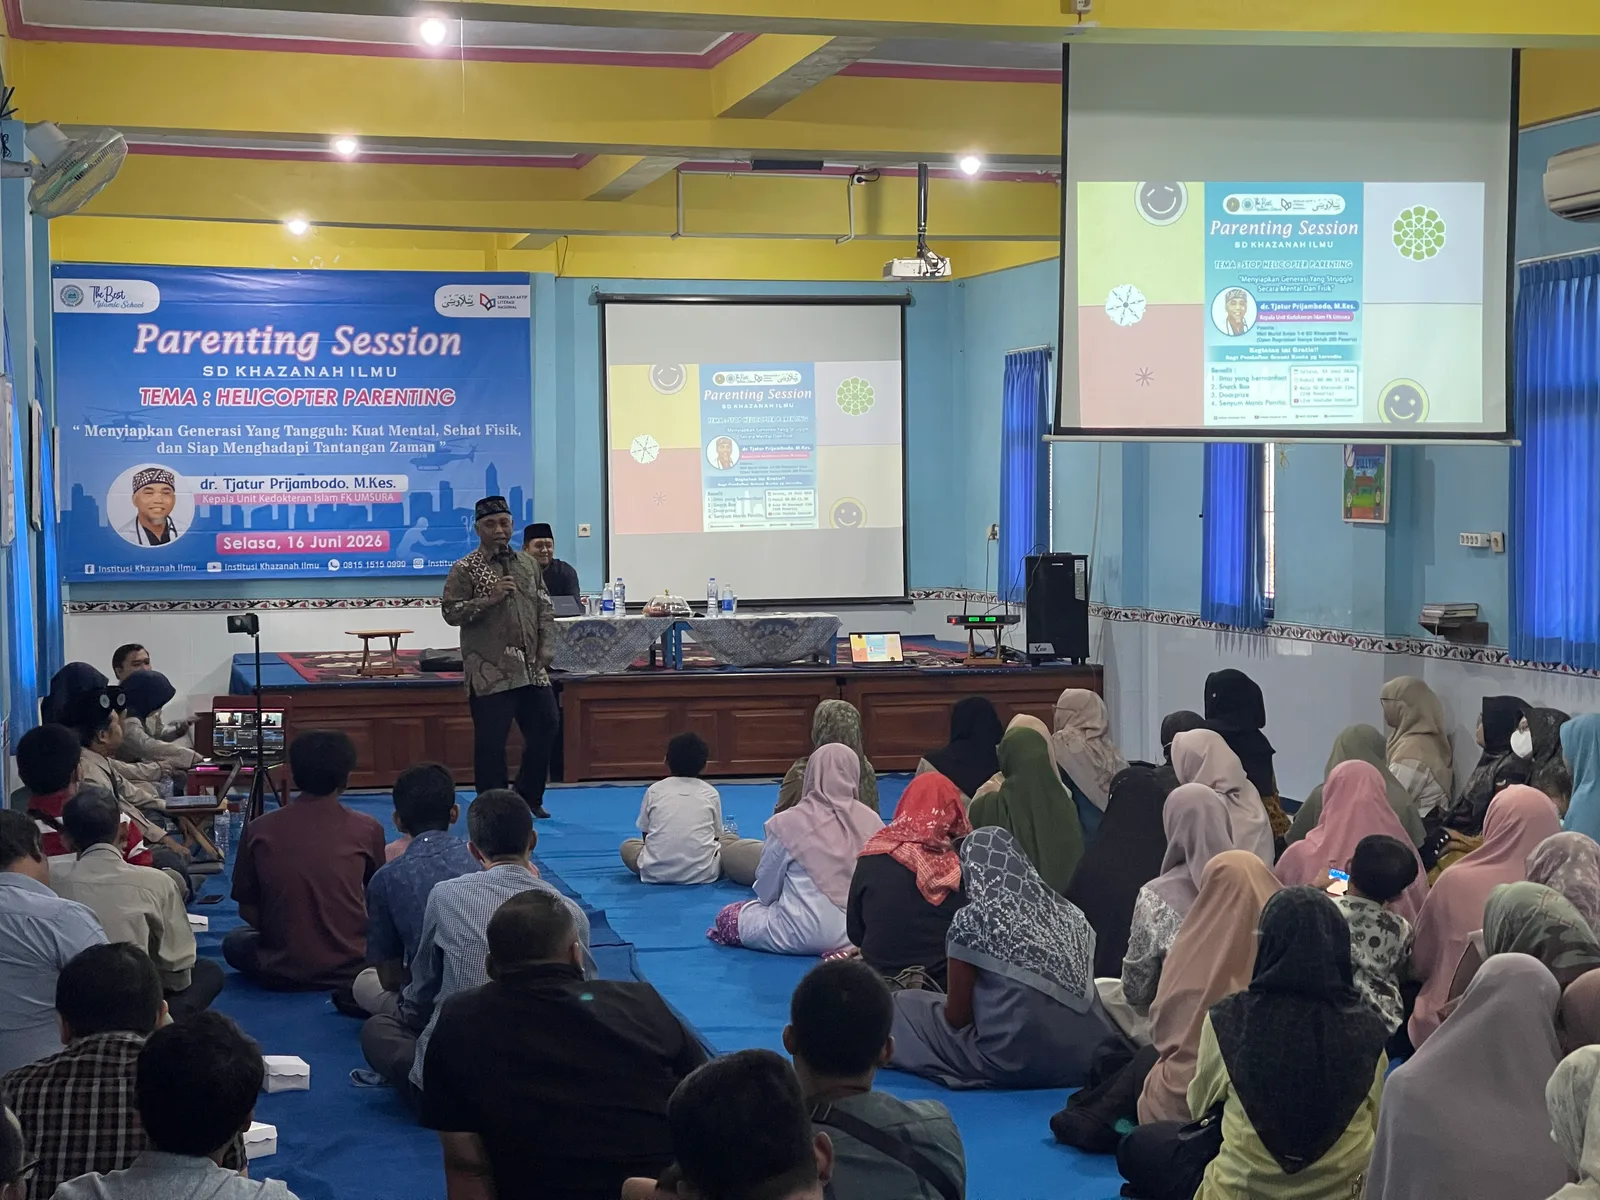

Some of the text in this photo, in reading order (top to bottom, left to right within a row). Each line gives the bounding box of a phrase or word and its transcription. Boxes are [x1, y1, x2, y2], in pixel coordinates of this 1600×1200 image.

[1210, 220, 1359, 238] Parenting Session
[1214, 260, 1236, 269] TEMA
[1242, 260, 1262, 269] STOP
[1263, 260, 1309, 269] HELICOPTER
[1309, 260, 1353, 269] PARENTING
[1309, 275, 1325, 284] Yang
[1327, 275, 1353, 284] Struggle
[89, 286, 104, 303] The
[104, 286, 125, 303] Best
[1258, 285, 1279, 293] Secara
[1280, 285, 1303, 293] Mental
[121, 301, 144, 309] School
[1271, 303, 1291, 311] Tjatur
[133, 323, 462, 362] Parenting Session
[203, 366, 397, 378] SD KHAZANAH ILMU
[139, 387, 456, 406] TEMA : HELICOPTER PARENTING
[703, 388, 812, 402] Parenting Session
[84, 425, 173, 441] Menyiapkan
[177, 425, 241, 437] Generasi
[245, 425, 280, 440] Yang
[283, 424, 348, 441] Tangguh:
[352, 425, 384, 436] Kuat
[388, 424, 439, 439] Mental,
[443, 425, 481, 436] Sehat
[485, 424, 522, 438] Fisik,
[157, 441, 182, 454] dan
[187, 441, 218, 456] Siap
[223, 441, 310, 456] Menghadapi
[313, 441, 385, 455] Tantangan
[390, 441, 436, 453] Zaman
[200, 478, 217, 490] dr.
[223, 478, 265, 492] Tjatur
[354, 477, 396, 489] M.Kes.
[202, 493, 394, 504] Kepala Unit Kedokteran Islam FK UMSURA
[223, 535, 383, 550] Selasa, 16 Juni 2026
[135, 564, 175, 572] Khazanah
[178, 564, 197, 572] Ilmu
[224, 562, 320, 571] Institusi Khazanah Ilmu
[343, 560, 362, 569] 0815
